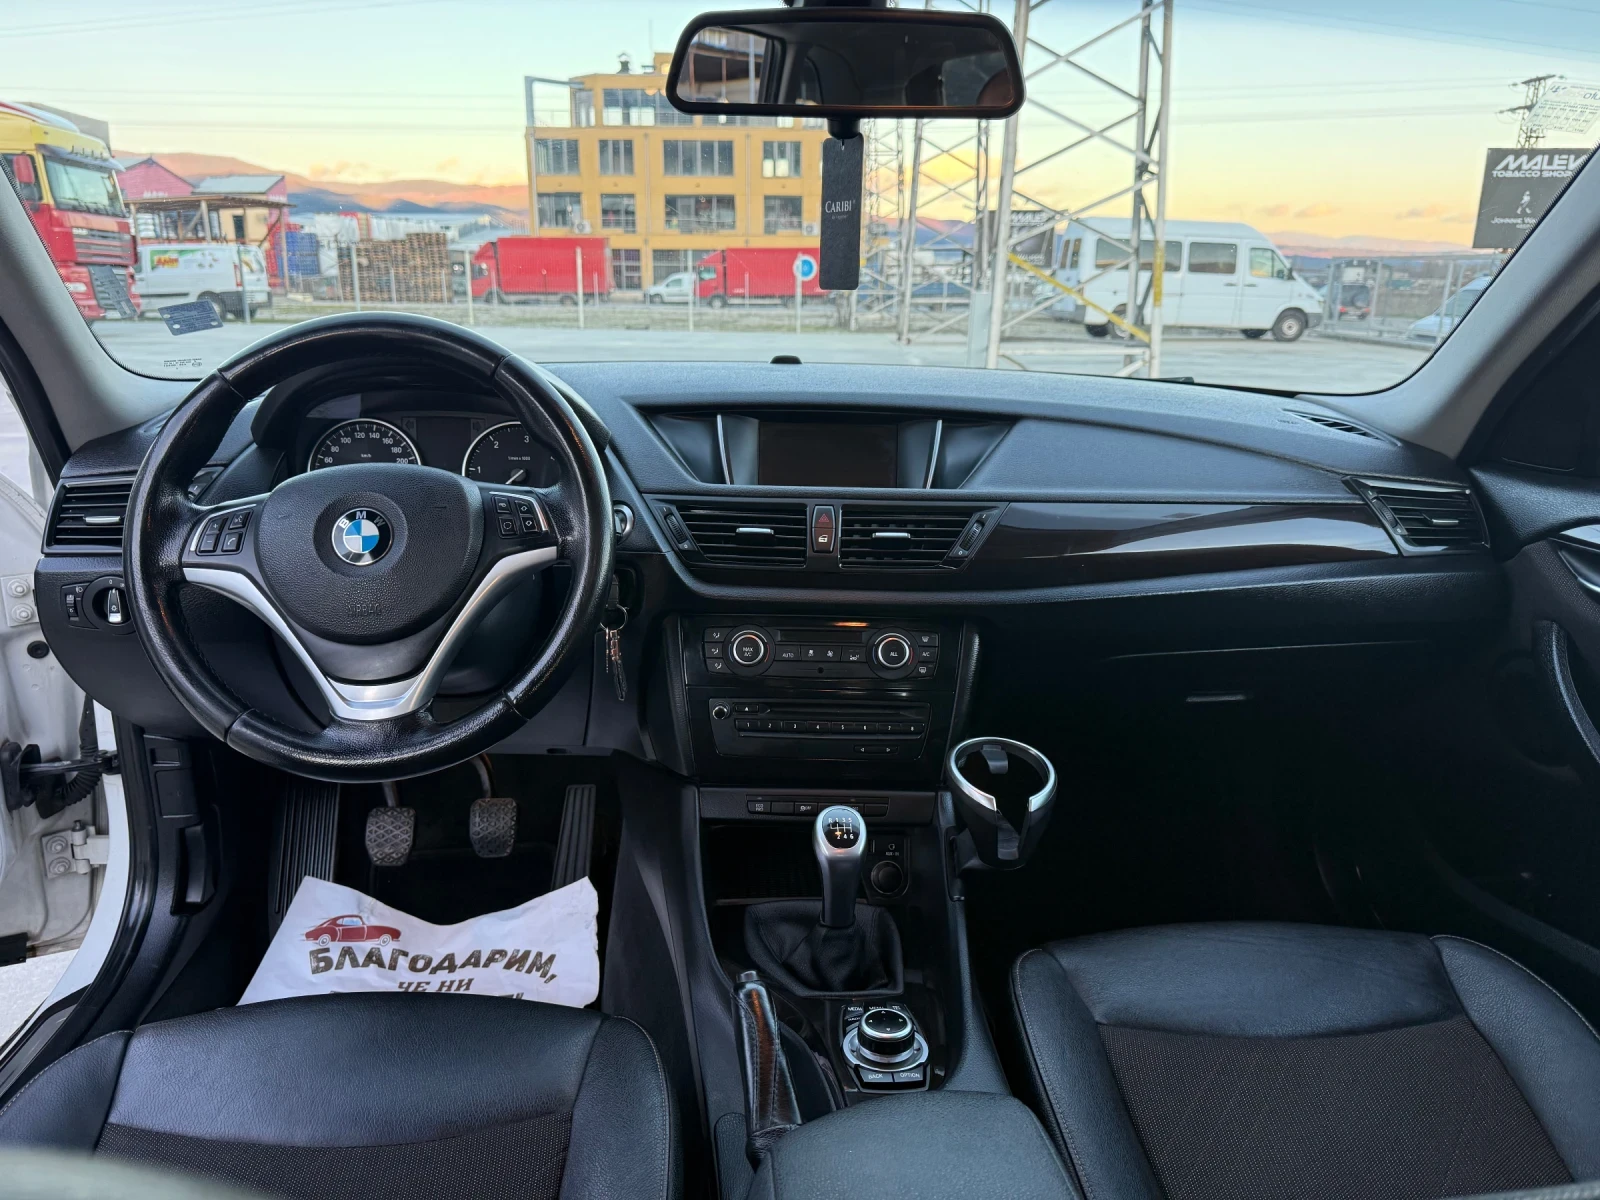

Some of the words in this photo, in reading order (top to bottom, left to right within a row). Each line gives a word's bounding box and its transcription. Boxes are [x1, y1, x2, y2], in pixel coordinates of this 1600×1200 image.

[1492, 170, 1540, 178] TOBACCO
[382, 437, 394, 445] 160
[523, 435, 530, 443] 3
[330, 445, 340, 453] 80
[493, 441, 499, 449] 2
[390, 446, 402, 454] 180
[339, 510, 386, 529] BMW
[309, 946, 557, 984] БЛАГОДАРИМ,
[398, 981, 430, 992] ЧЕ
[435, 978, 474, 992] НИ
